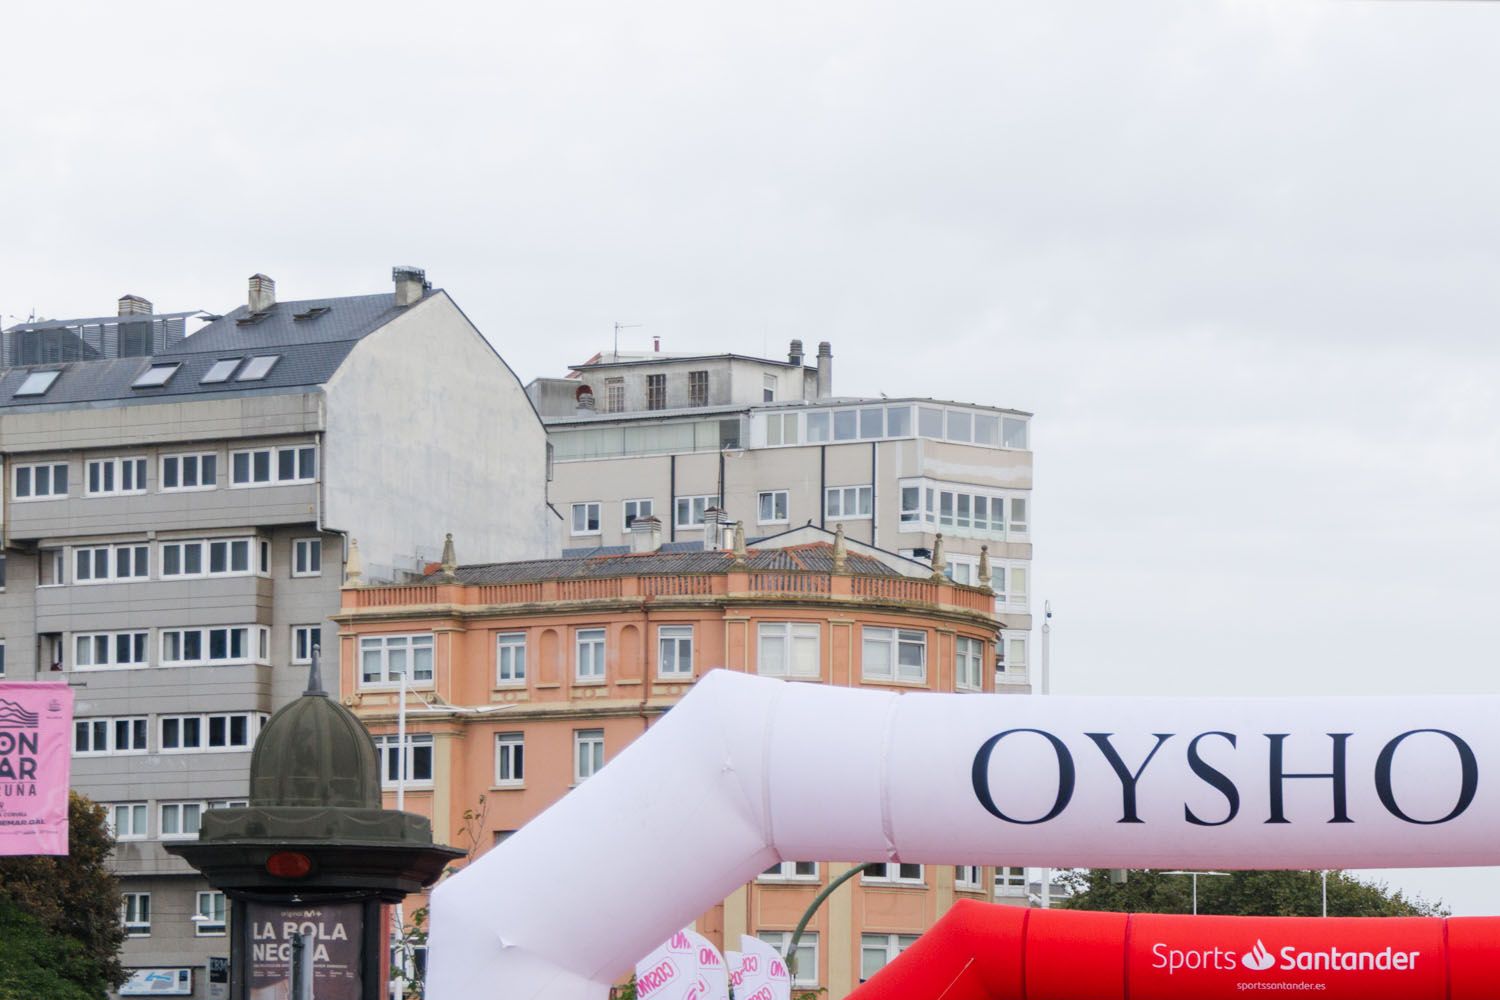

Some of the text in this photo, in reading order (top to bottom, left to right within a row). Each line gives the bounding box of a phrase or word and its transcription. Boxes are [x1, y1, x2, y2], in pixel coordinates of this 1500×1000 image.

[971, 727, 1480, 827] OYSHO
[0, 782, 37, 797] UÑA
[253, 921, 348, 941] LA BOLA
[253, 943, 331, 962] NEGA
[1152, 943, 1420, 975] Sports Santander
[1237, 981, 1326, 991] sportssantander.es
